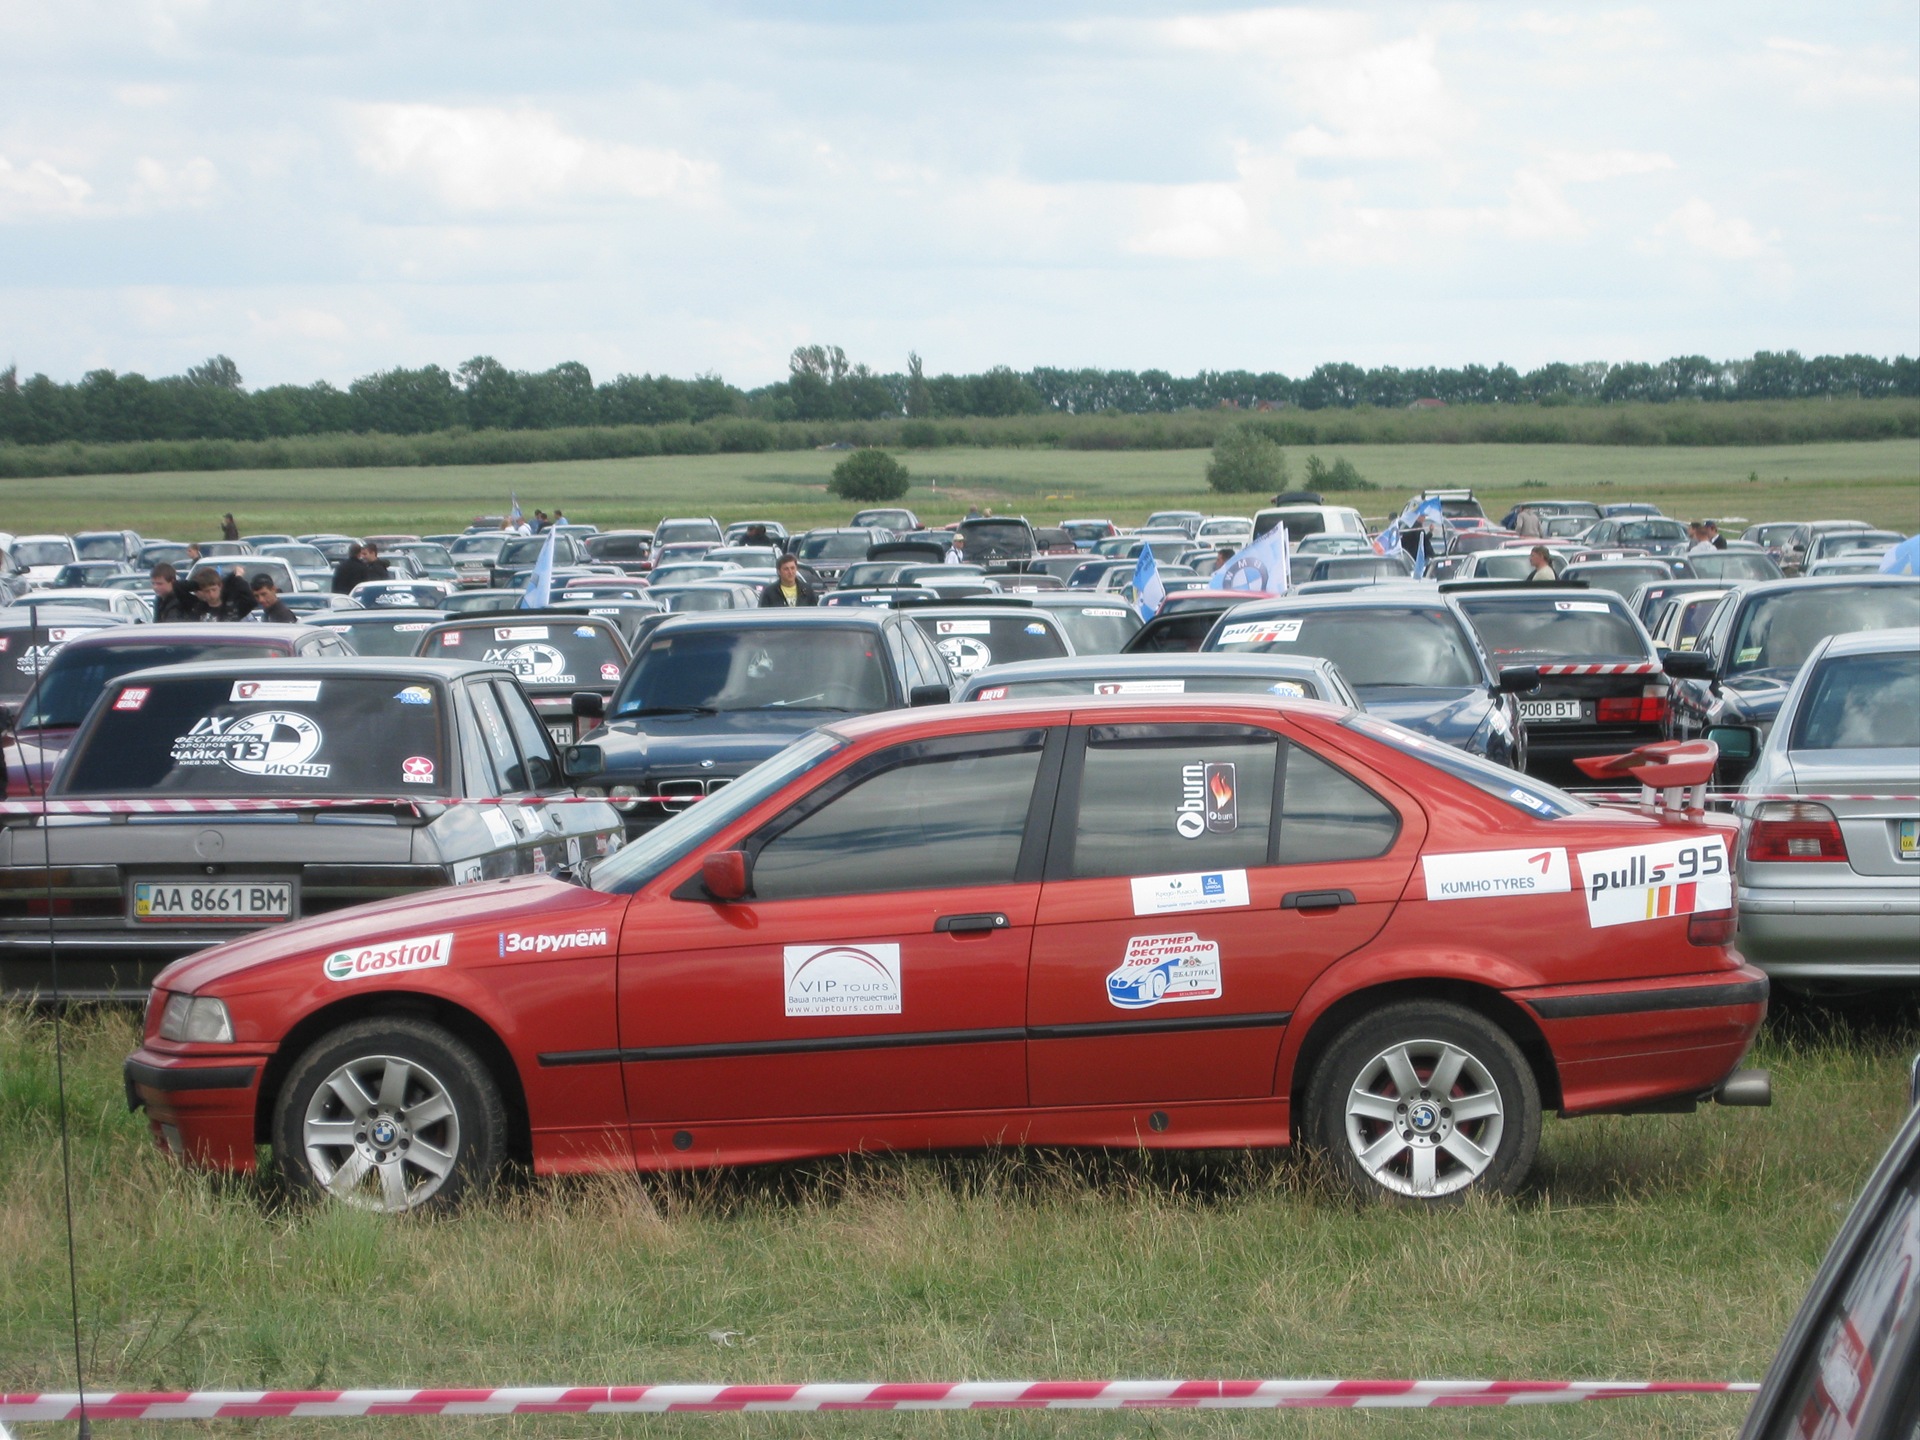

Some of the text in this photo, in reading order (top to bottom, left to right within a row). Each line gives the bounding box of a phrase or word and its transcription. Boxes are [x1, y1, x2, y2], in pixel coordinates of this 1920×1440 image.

[512, 664, 533, 675] 13
[1556, 702, 1576, 716] BT
[188, 717, 234, 735] IX
[238, 714, 313, 734] BMW
[174, 735, 259, 743] ФЕСТИВАЛЬ
[170, 749, 228, 760] ЧАЙКА
[232, 743, 265, 759] 13
[264, 764, 329, 776] ИЮНЯ
[1902, 840, 1914, 848] UA
[1440, 877, 1535, 894] KUMHO TYRES
[152, 888, 284, 911] AA 8661 BM
[1132, 935, 1194, 948] ПАРТНЕР
[355, 938, 441, 973] Castrol
[1129, 943, 1215, 957] ФЕСТИВАЛЮ
[1127, 957, 1160, 967] 2009
[799, 980, 889, 993] VIP TOURS
[788, 992, 898, 1004] Ваша планета путешествий
[787, 1004, 900, 1014] www.viptours.com.ua
